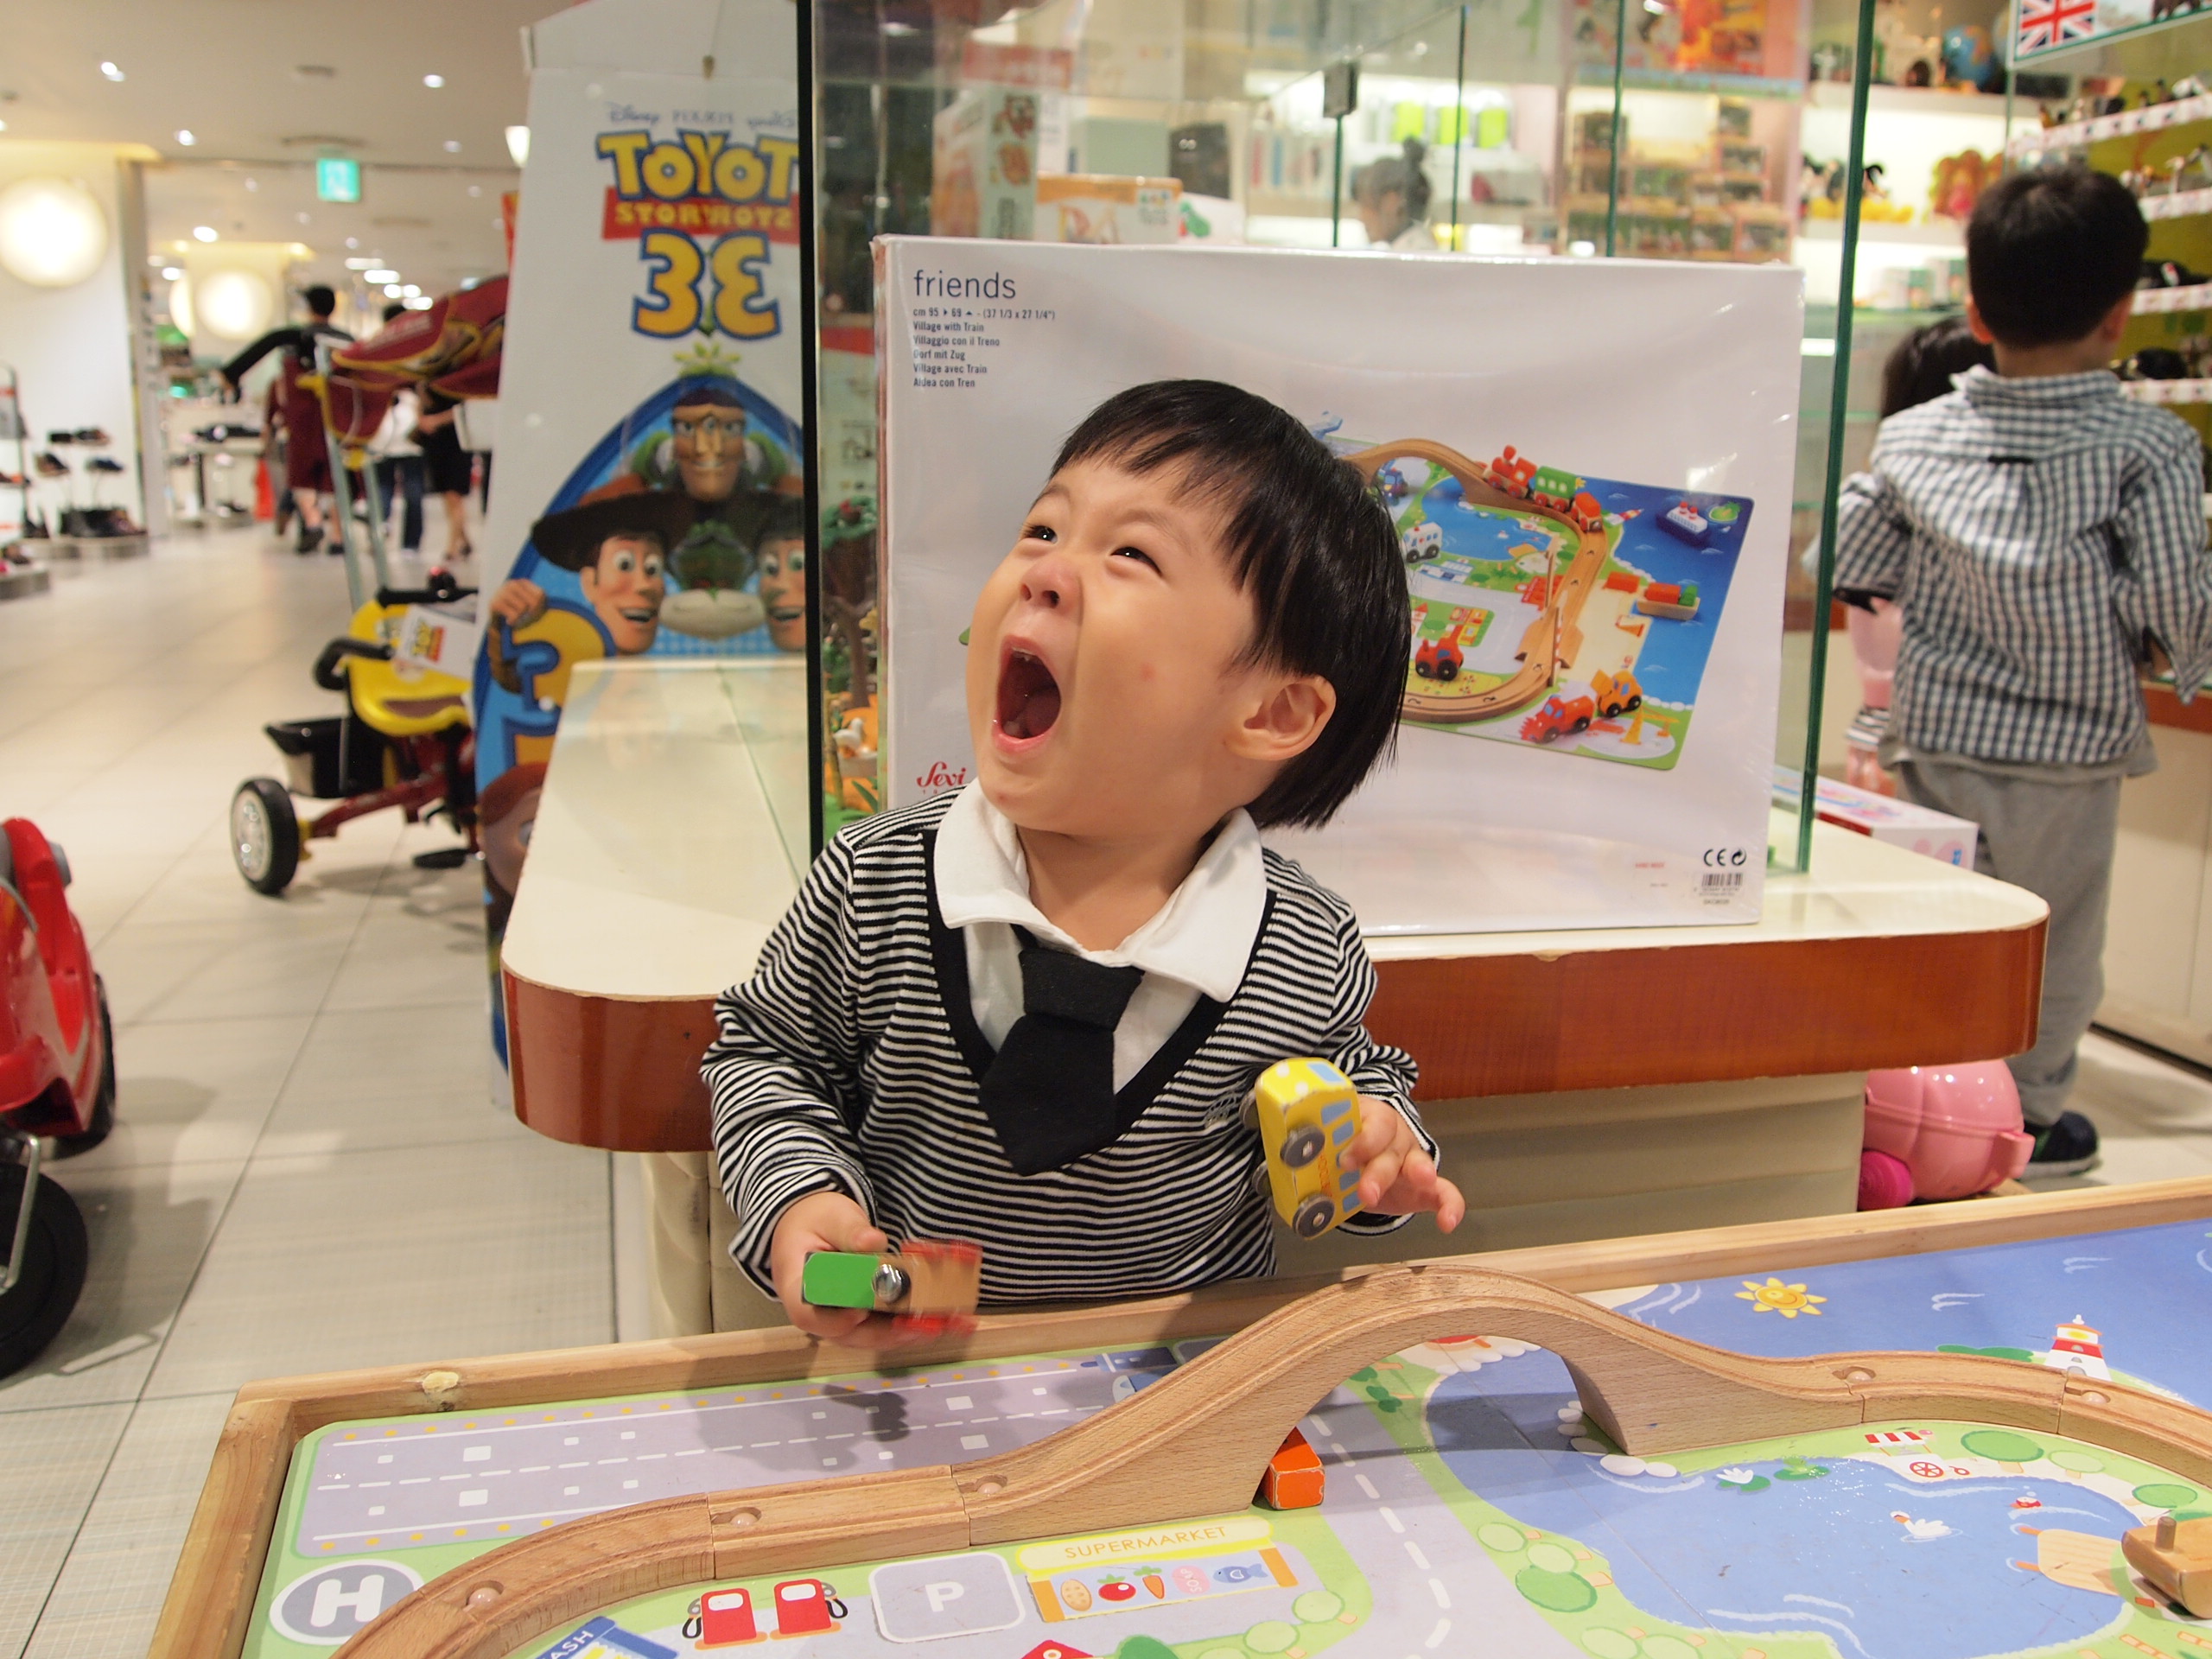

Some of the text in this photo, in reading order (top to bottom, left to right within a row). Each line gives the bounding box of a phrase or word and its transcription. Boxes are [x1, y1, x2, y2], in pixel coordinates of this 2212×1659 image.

[913, 270, 1016, 299] friends
[929, 308, 938, 316] 95
[1000, 308, 1013, 318] 1/3
[1022, 309, 1032, 319] 27
[913, 321, 984, 333] Village with Train
[913, 335, 949, 346] Villaggio
[977, 337, 1000, 346] Treno
[913, 349, 965, 361] Dorf mit Zug
[913, 364, 942, 374] Village
[967, 364, 987, 373] Train
[913, 378, 937, 387] Aldea
[957, 378, 976, 387] Tren
[1065, 1527, 1226, 1559] SUPERMARKET
[310, 1574, 385, 1628] H
[925, 1580, 964, 1612] P
[543, 1630, 594, 1659] ASH
